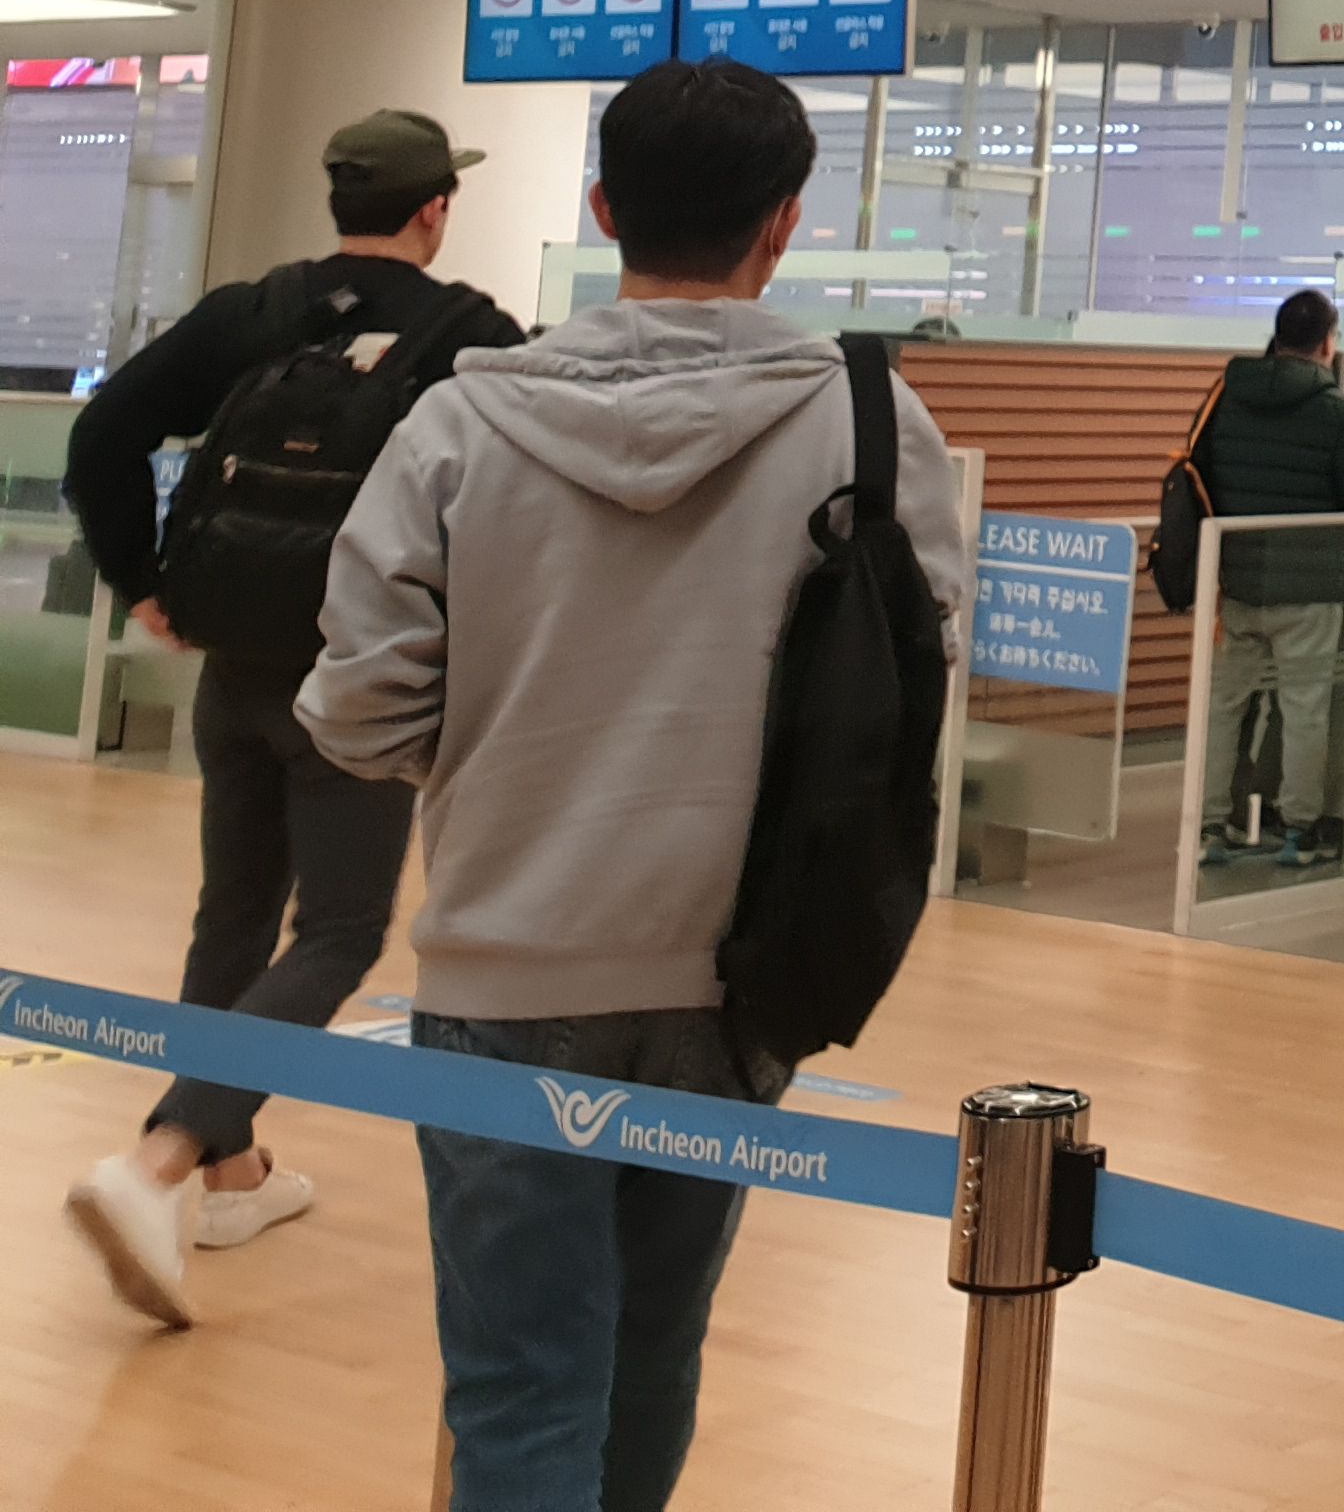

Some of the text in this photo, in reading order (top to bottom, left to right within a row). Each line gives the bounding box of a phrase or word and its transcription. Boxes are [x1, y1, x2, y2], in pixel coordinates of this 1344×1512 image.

[978, 524, 1109, 562] EASE WAIT
[14, 1000, 166, 1058] Incheon Airport
[620, 1115, 827, 1183] Incheon Airport
